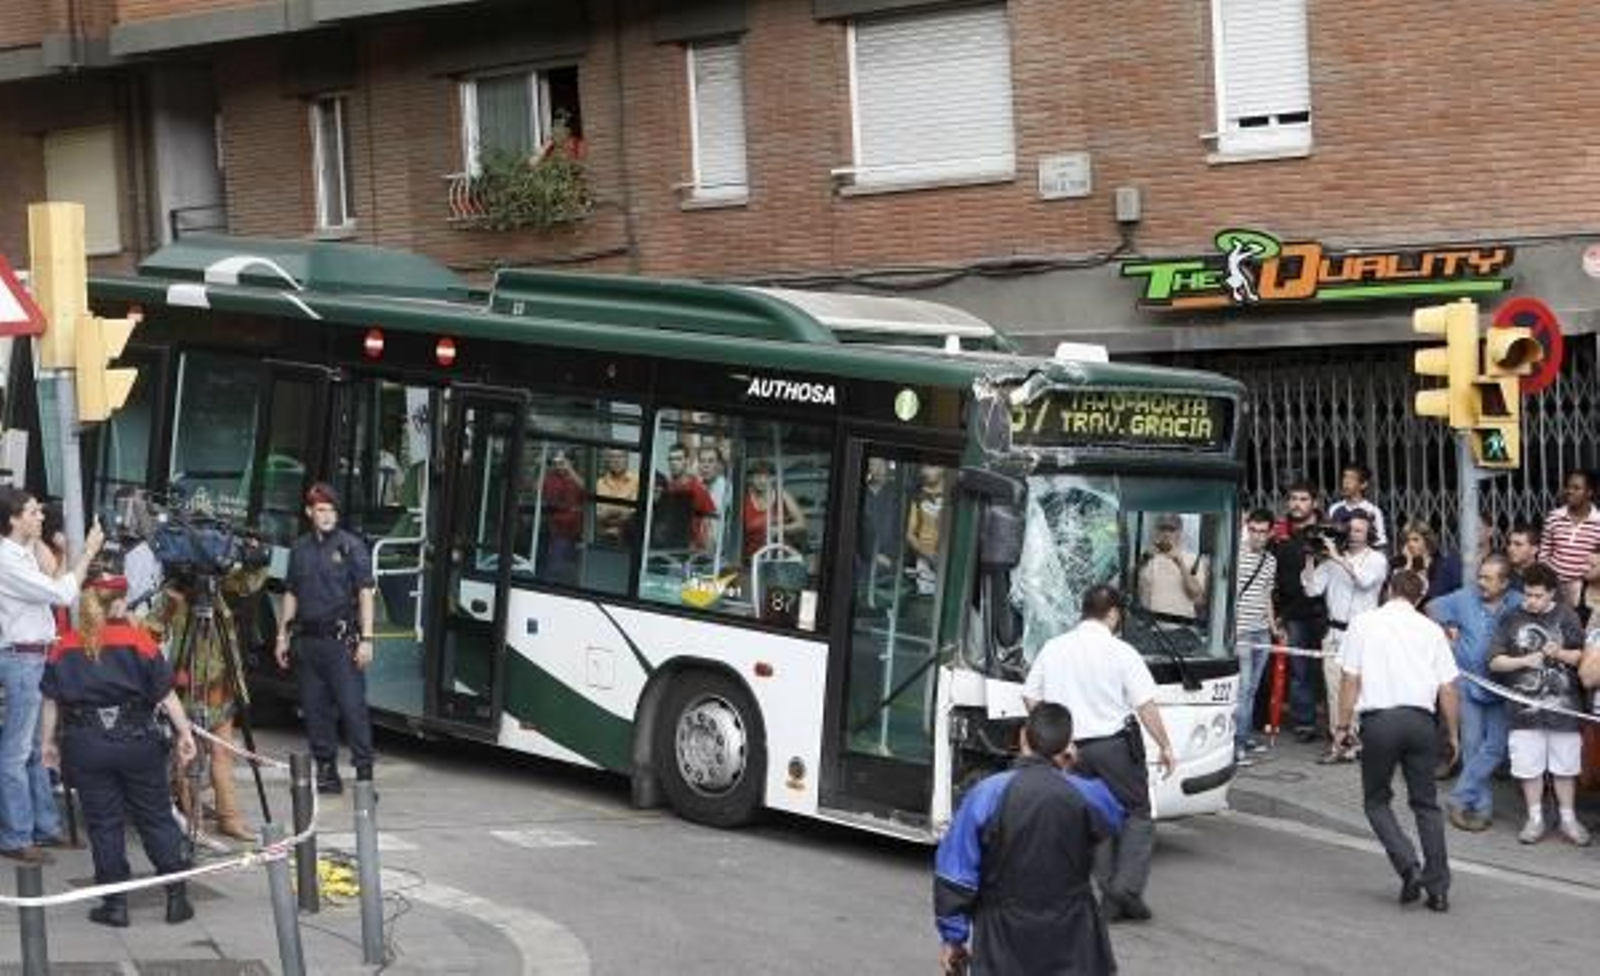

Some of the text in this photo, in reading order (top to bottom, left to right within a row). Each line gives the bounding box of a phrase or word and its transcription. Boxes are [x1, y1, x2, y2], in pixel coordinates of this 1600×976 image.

[1122, 243, 1507, 300] THE QUALITY
[747, 376, 836, 405] AUTHOSA
[1061, 410, 1213, 440] TRAV. GRACIA
